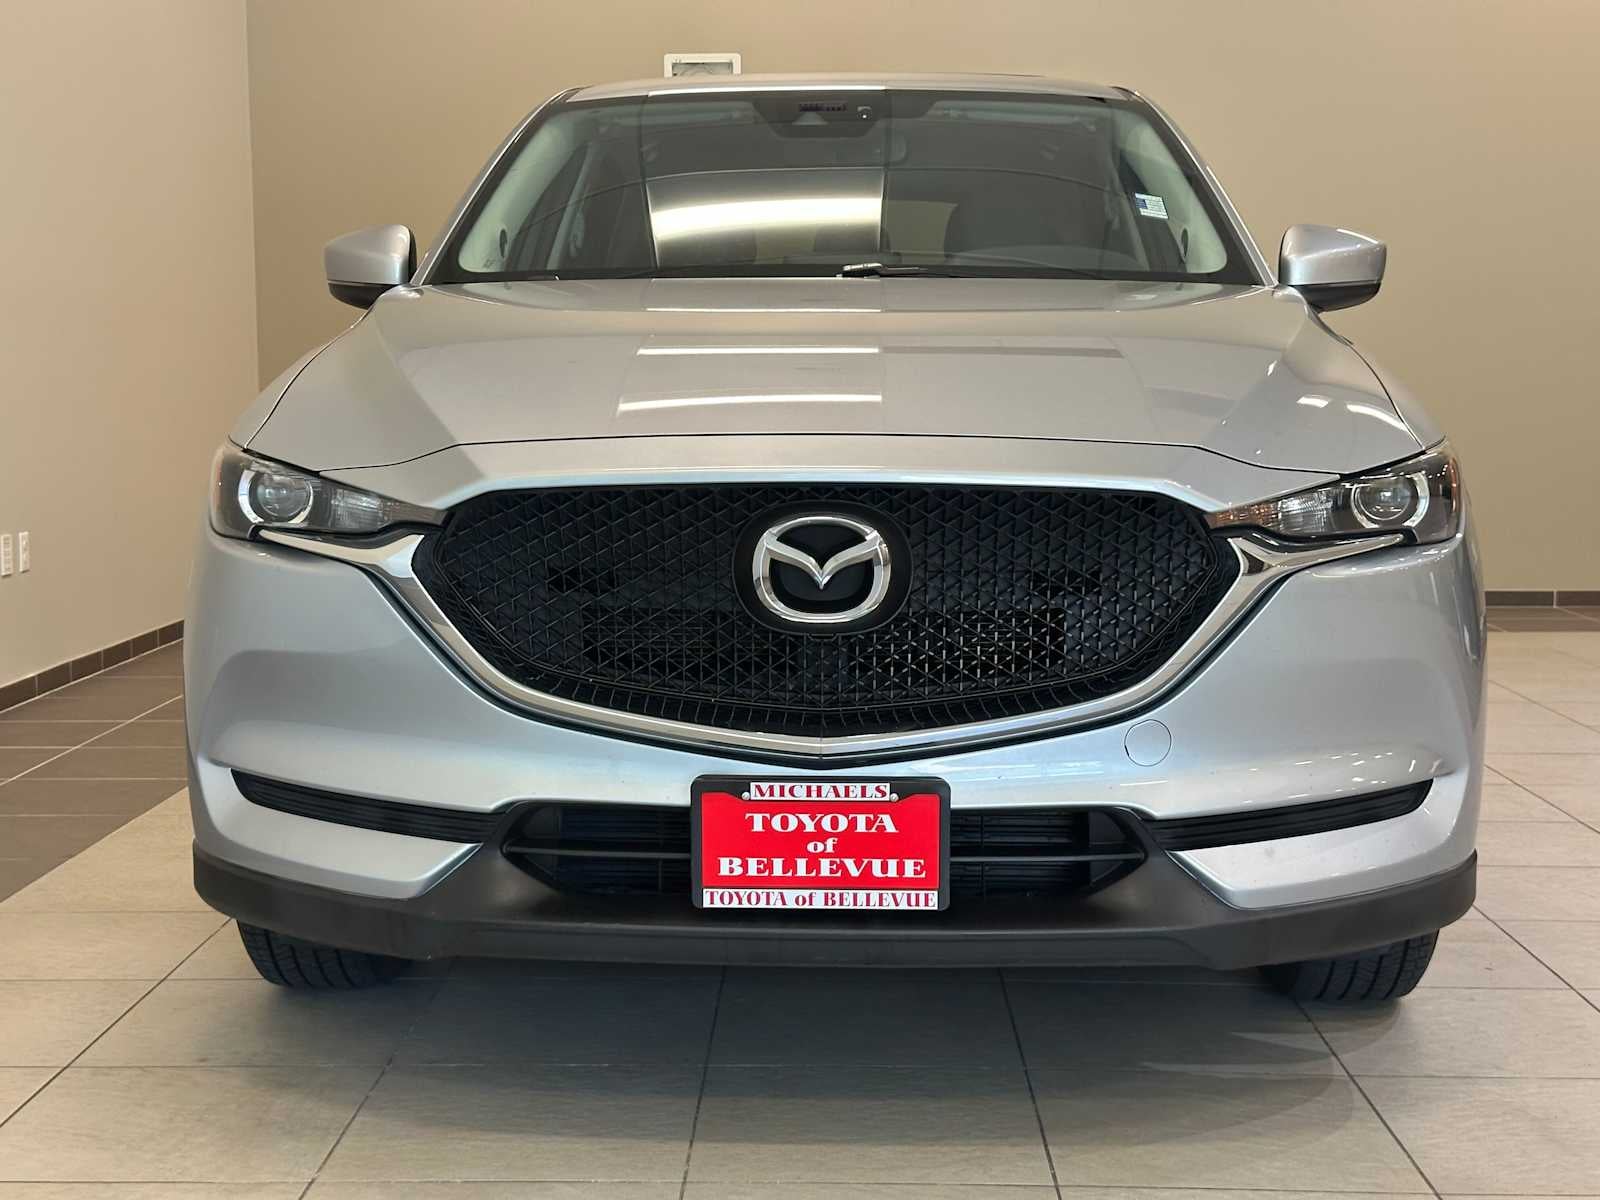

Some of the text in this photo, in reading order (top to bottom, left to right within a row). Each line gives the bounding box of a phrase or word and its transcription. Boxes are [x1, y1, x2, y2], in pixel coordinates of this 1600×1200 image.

[754, 784, 888, 799] MICHAELS
[745, 813, 899, 833] TOYOTA
[807, 838, 838, 854] of
[717, 857, 927, 878] BELLEVUE
[705, 891, 936, 908] TOYOTA of BELLEVUE
